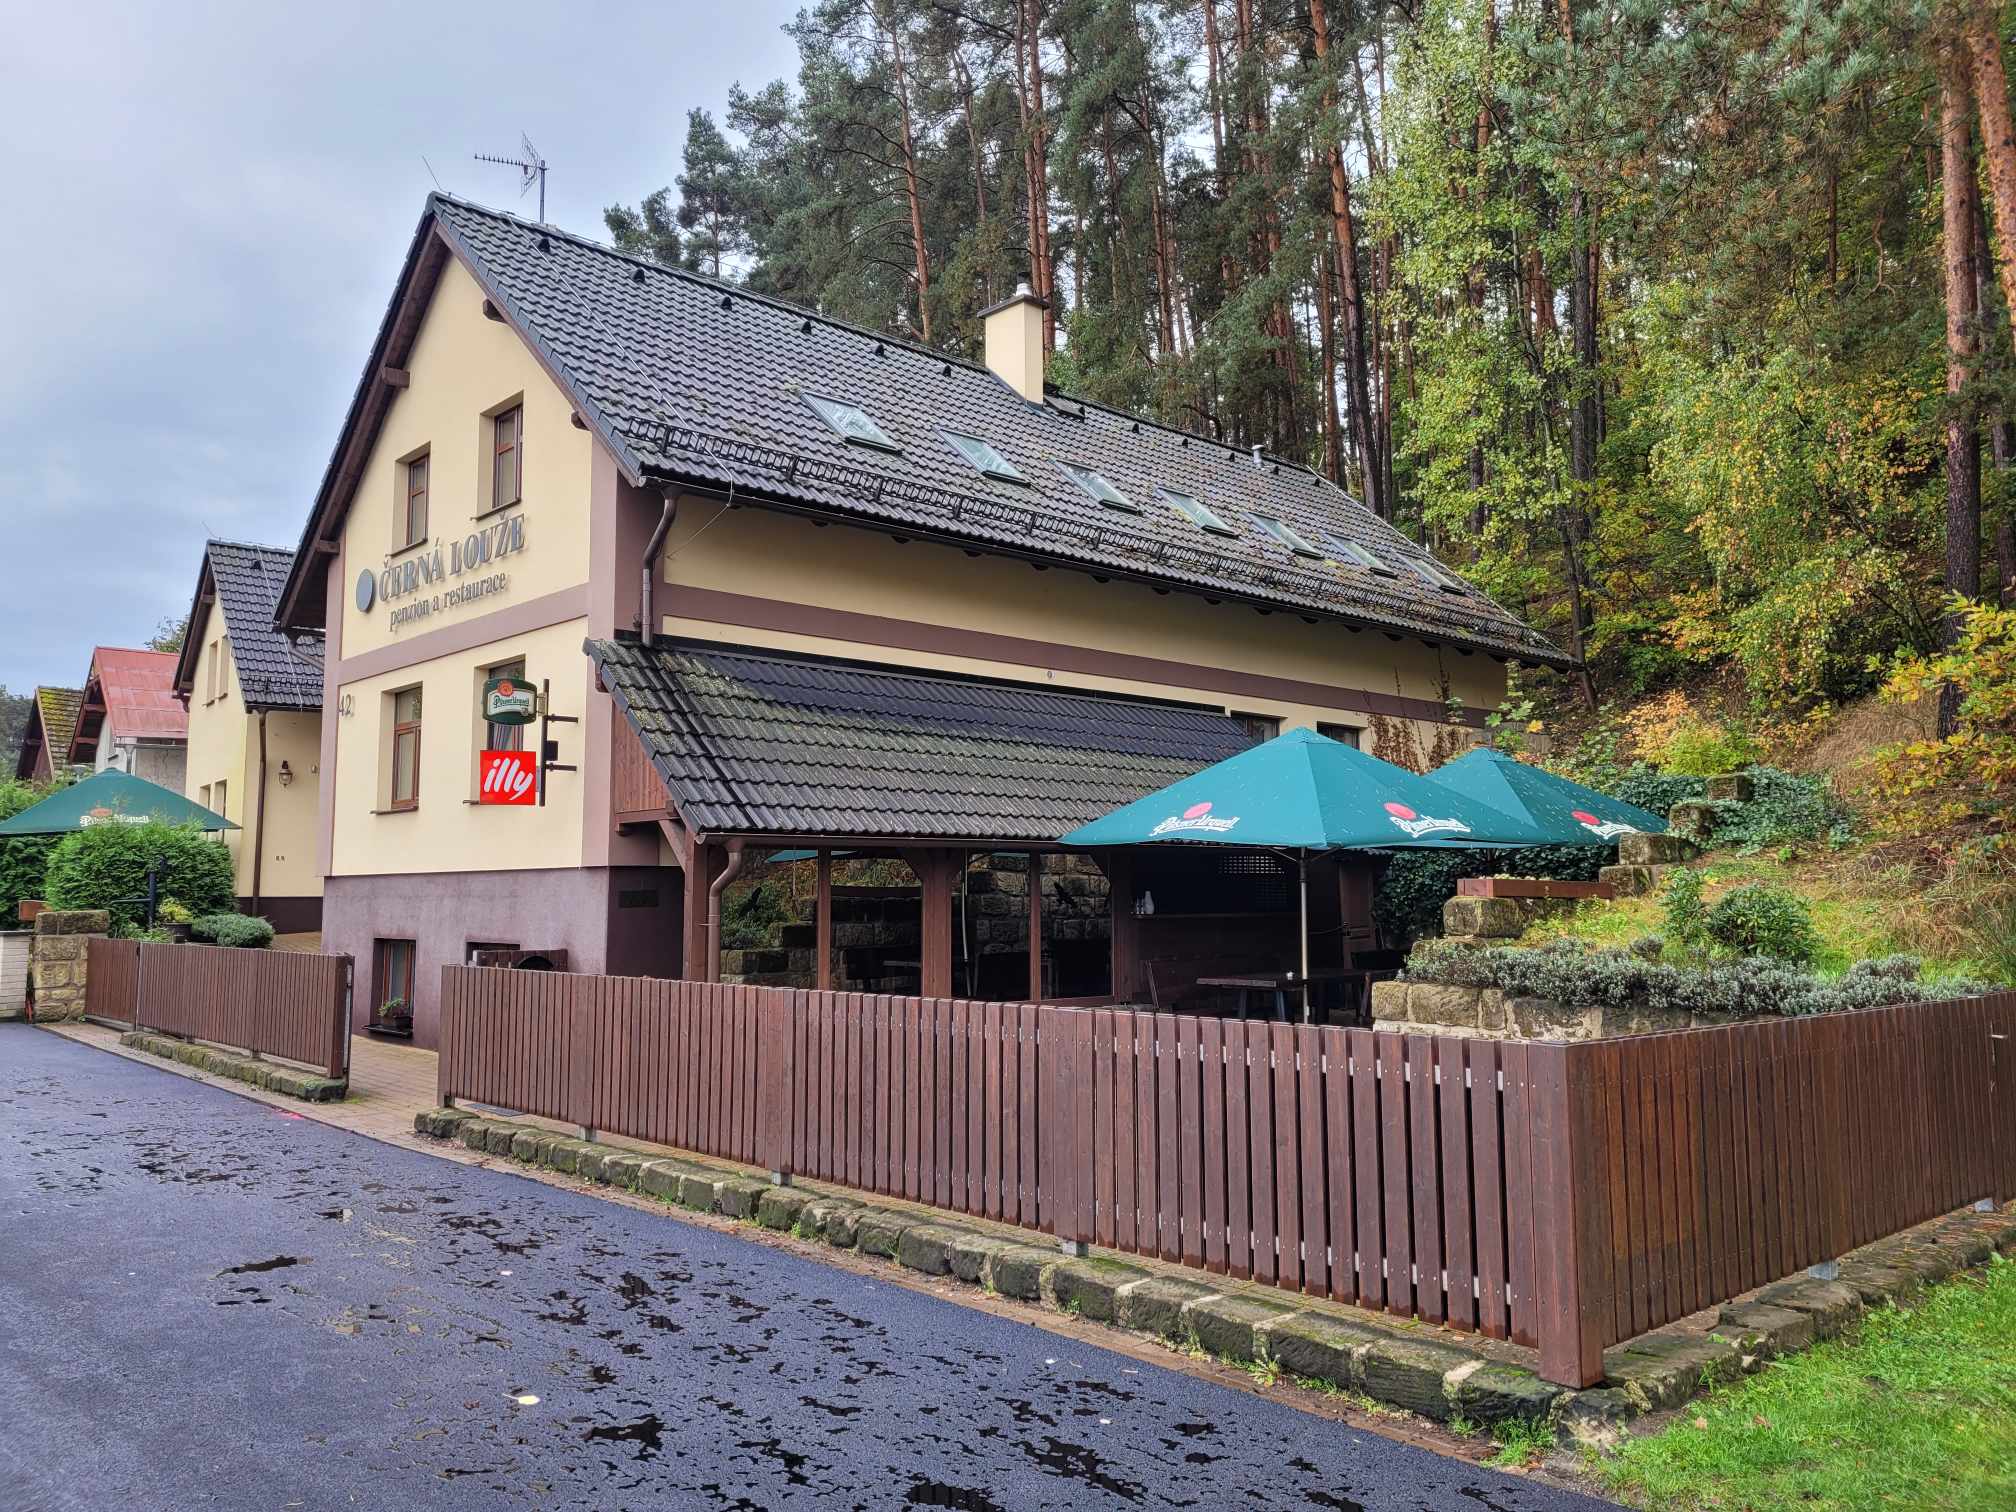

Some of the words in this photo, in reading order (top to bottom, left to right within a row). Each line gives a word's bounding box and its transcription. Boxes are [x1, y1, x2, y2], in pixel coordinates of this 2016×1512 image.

[378, 537, 444, 602] ČERNÁ
[449, 511, 526, 576] LOUŽE
[390, 598, 430, 632] penzion
[432, 594, 440, 612] a
[443, 572, 506, 609] restaurace
[483, 758, 534, 801] illy
